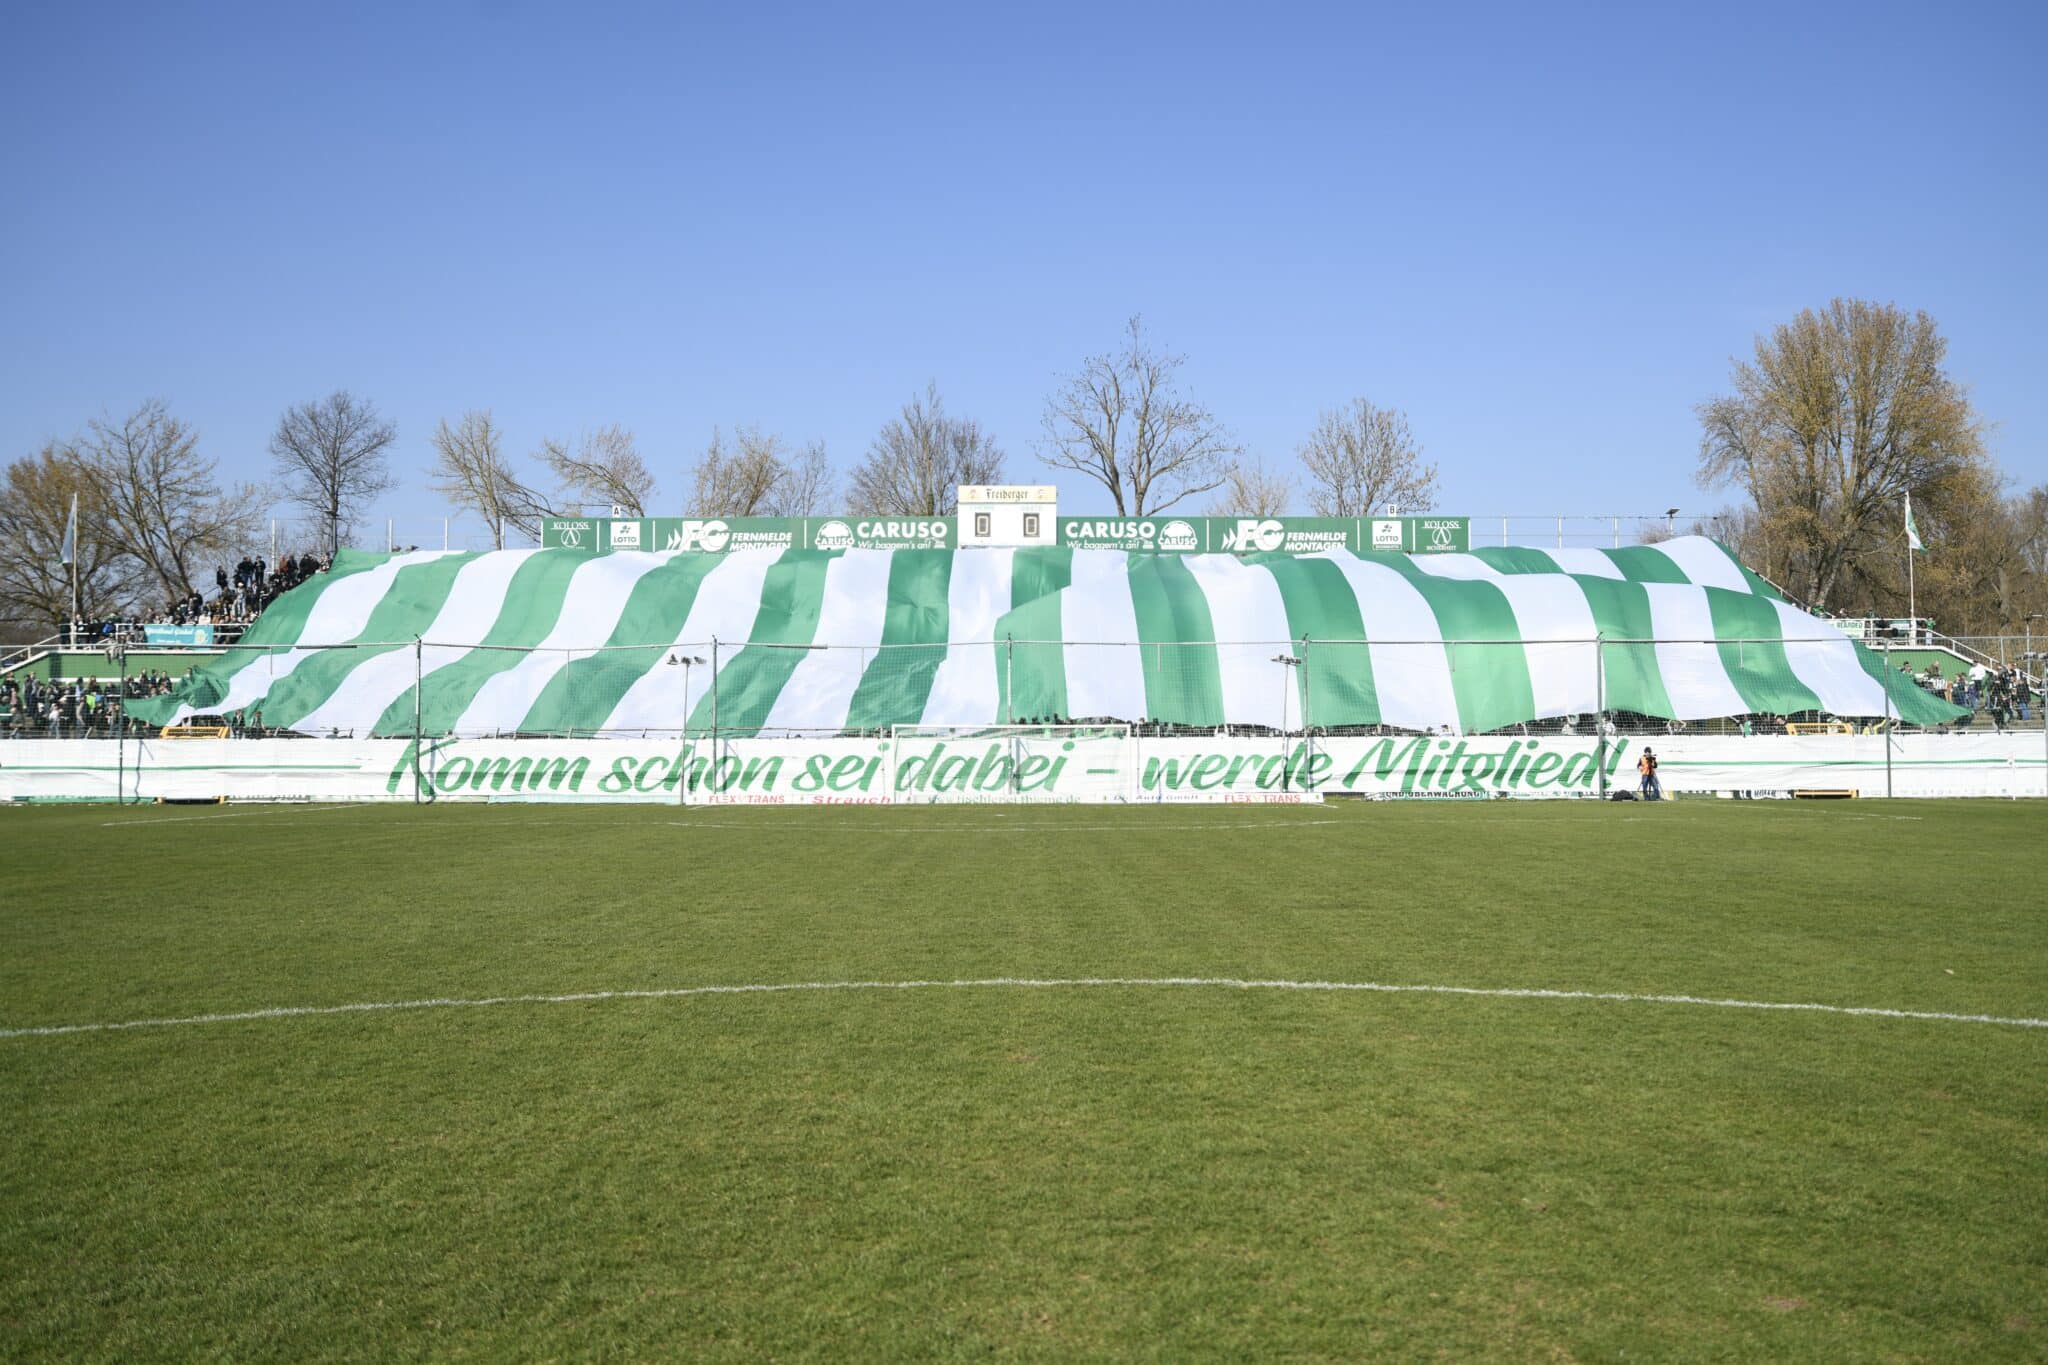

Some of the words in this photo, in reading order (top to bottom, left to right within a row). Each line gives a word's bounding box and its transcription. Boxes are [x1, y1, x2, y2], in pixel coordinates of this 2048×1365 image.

[986, 488, 1028, 502] Freiberger
[613, 507, 620, 515] A
[553, 521, 589, 529] KOLOSS
[1424, 520, 1459, 528] KOLOSS
[857, 521, 947, 538] CARUSO
[1065, 521, 1156, 538] CARUSO
[731, 532, 792, 541] FERNMELDE
[1157, 537, 1198, 545] CARUSO
[1287, 532, 1347, 541] FERNMELDE
[815, 537, 855, 546] CARUSO
[1284, 541, 1346, 551] MONTAGEN
[729, 542, 791, 552] MONTAGEN
[386, 738, 591, 797] Komm
[597, 743, 784, 793] schon
[791, 742, 890, 792] sei
[895, 742, 1075, 792] dabei
[1142, 741, 1333, 790] werde
[1342, 736, 1629, 793] Mitglied!
[748, 795, 784, 803] TRANS
[813, 795, 891, 804] Strauch
[1264, 795, 1300, 803] TRANS
